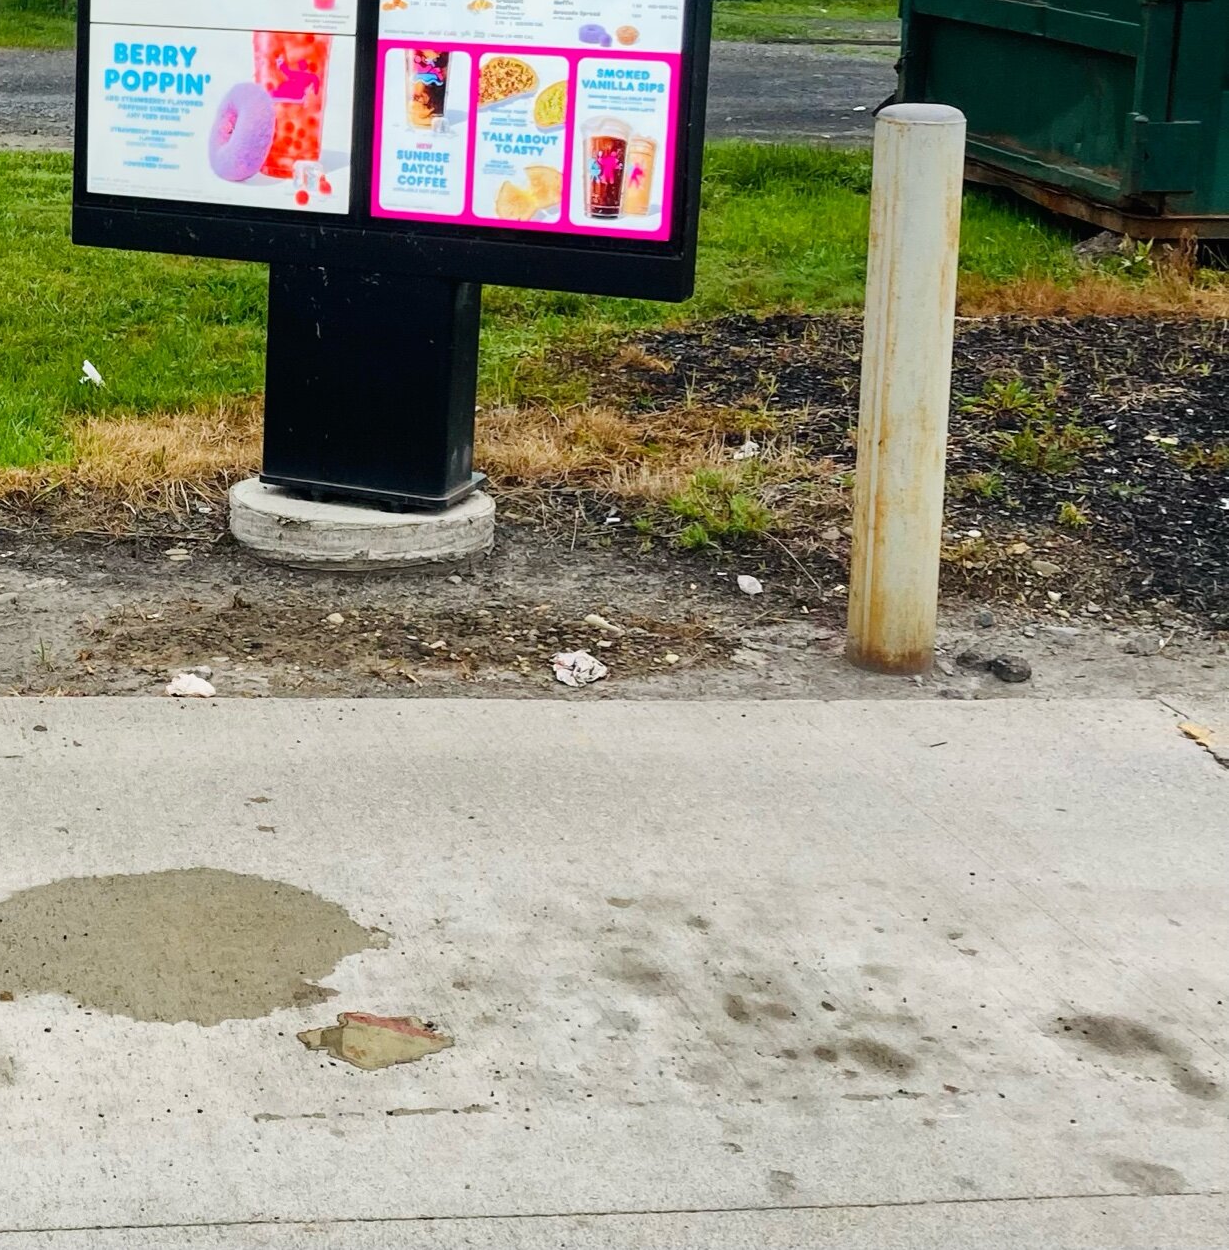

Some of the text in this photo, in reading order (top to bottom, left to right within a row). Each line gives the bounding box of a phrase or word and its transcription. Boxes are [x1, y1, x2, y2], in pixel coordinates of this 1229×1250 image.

[114, 42, 197, 68] BERRY
[596, 68, 650, 80] SMOKED
[104, 69, 211, 96] POPPIN'
[581, 80, 665, 93] VANILLA SIPS
[482, 131, 558, 145] TALK ABOUT
[397, 150, 450, 163] SUNRISE
[495, 144, 544, 156] TOASTY
[402, 162, 444, 175] BATCH
[397, 175, 447, 188] COFFEE
